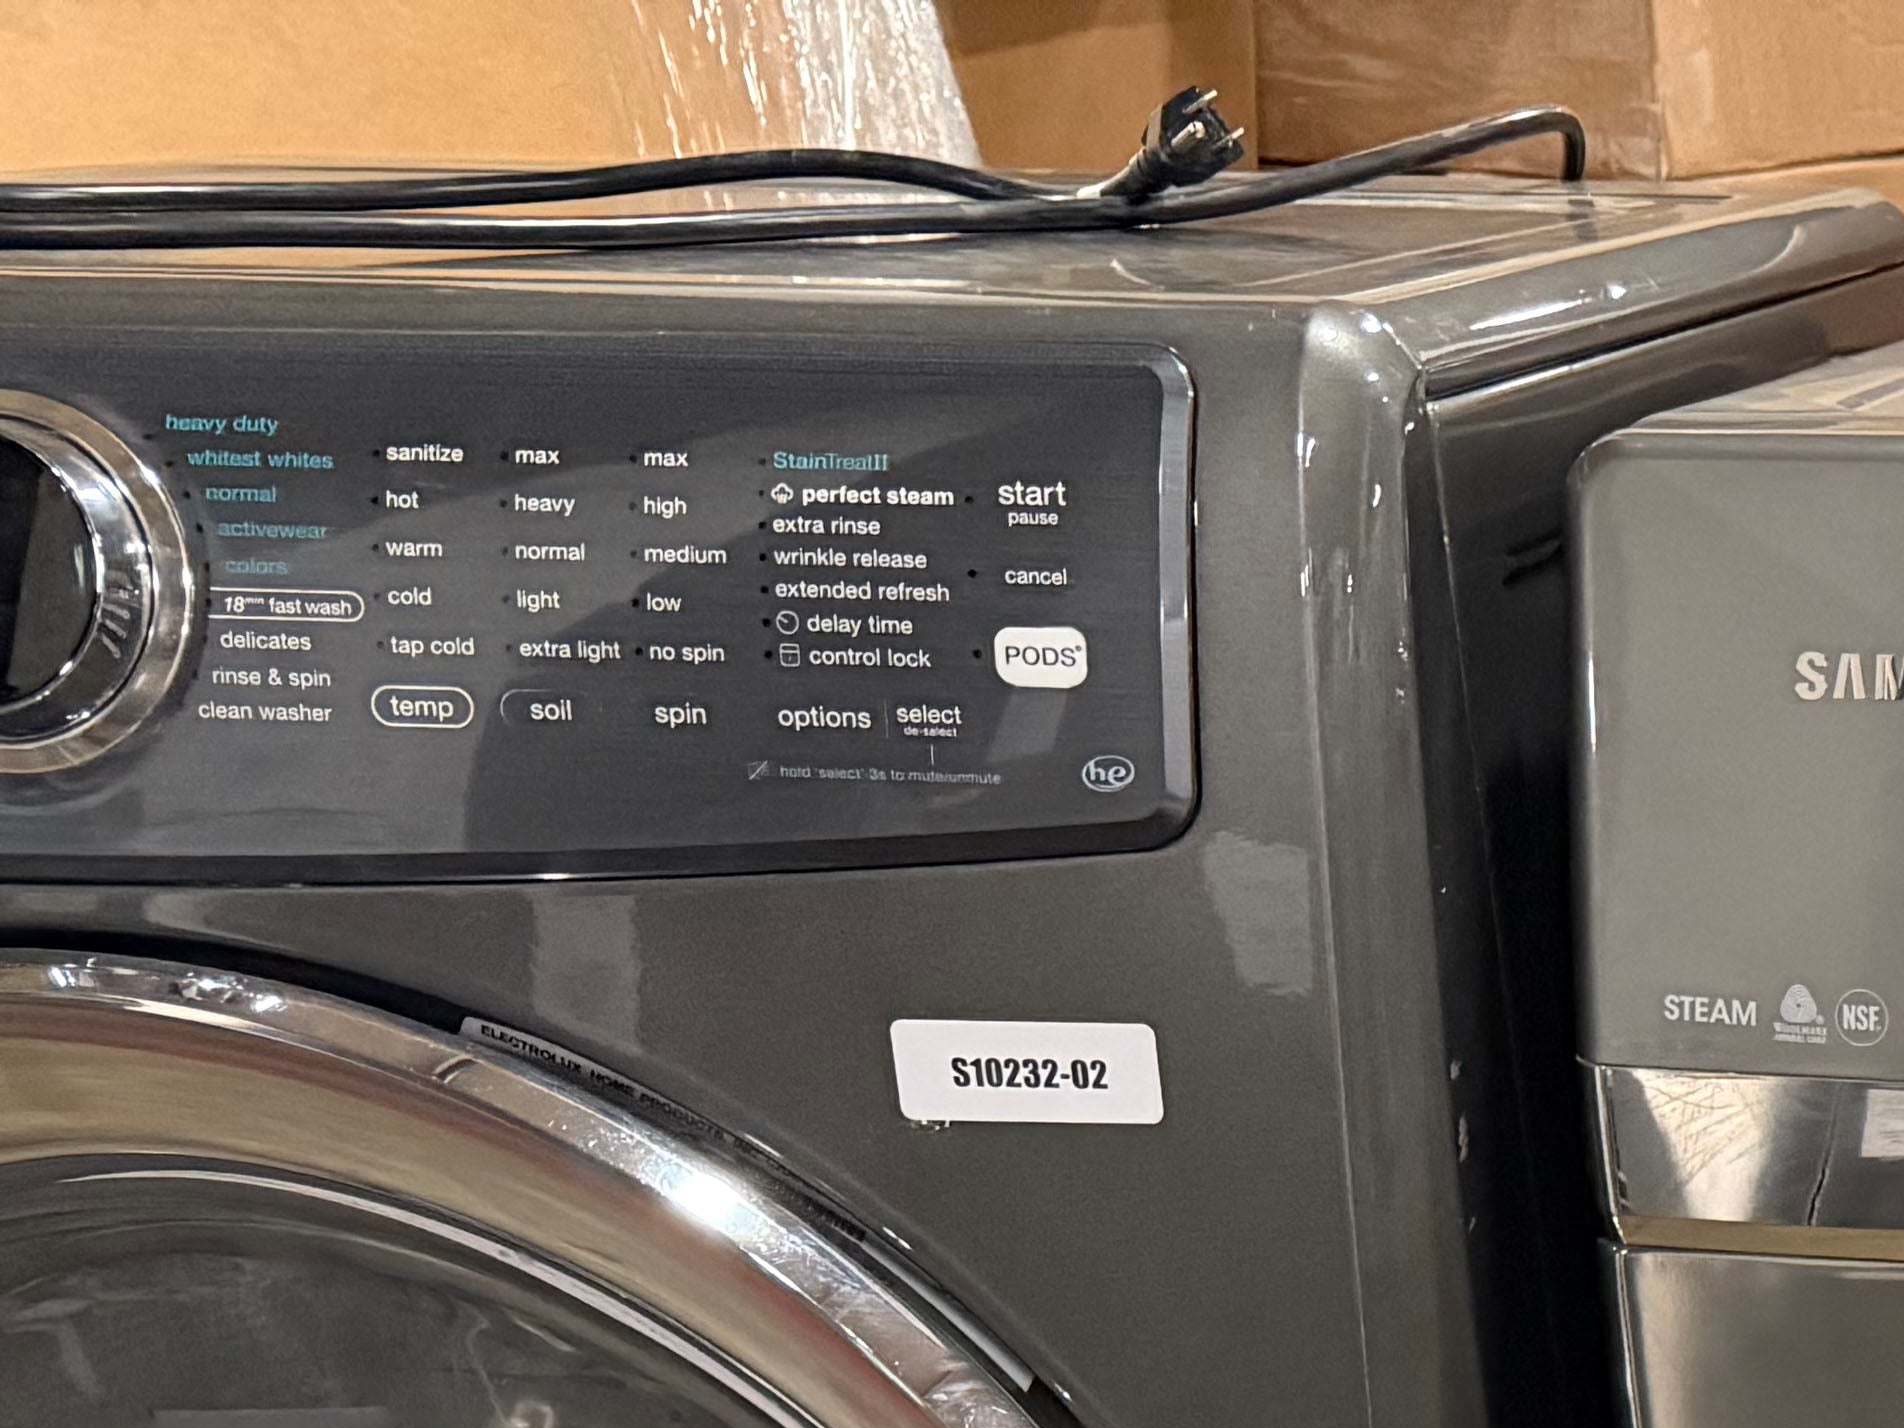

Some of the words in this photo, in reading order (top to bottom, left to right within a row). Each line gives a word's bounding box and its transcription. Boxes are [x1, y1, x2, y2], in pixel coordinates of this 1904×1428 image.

[166, 413, 226, 436] heavy
[233, 415, 279, 437] duty
[187, 450, 261, 467] whitest
[268, 452, 334, 469] whites
[386, 443, 464, 463] sanitize
[515, 449, 560, 465] max
[643, 451, 689, 468] max
[206, 486, 277, 503] normal
[385, 490, 419, 509] hot
[802, 485, 882, 506] perfect
[886, 487, 955, 506] steam
[998, 480, 1067, 507] start
[514, 493, 576, 517] heavy
[643, 495, 687, 519] high
[772, 516, 825, 534] extra
[830, 516, 881, 535] rinse
[1007, 511, 1059, 527] pause
[218, 521, 327, 539] activewear
[385, 541, 443, 557] warm
[515, 543, 586, 562] normal
[644, 545, 727, 565] medium
[774, 547, 847, 567] wrinkle
[853, 549, 928, 569] release
[226, 557, 288, 575] colors
[1004, 568, 1068, 586] cancel
[387, 587, 432, 605] cold
[517, 589, 561, 613] light
[646, 592, 682, 612] low
[775, 581, 871, 600] extended
[878, 582, 950, 602] refresh
[269, 597, 302, 614] fast
[305, 600, 352, 616] wash
[806, 613, 862, 638] delay
[868, 614, 913, 635] time
[220, 631, 312, 651] delicates
[391, 636, 424, 658] tap
[430, 637, 475, 656] cold
[519, 640, 572, 659] extra
[578, 640, 622, 664] light
[649, 645, 675, 661] no
[681, 643, 725, 665] spin
[809, 648, 881, 667] control
[888, 648, 932, 668] lock
[212, 666, 262, 686] rinse
[268, 668, 283, 686] &
[288, 669, 331, 690] spin
[198, 701, 253, 720] clean
[258, 703, 332, 722] washer
[390, 695, 454, 722] temp
[530, 699, 573, 721] soil
[655, 702, 707, 729] spin
[778, 705, 872, 732] options
[896, 704, 962, 725] select
[1664, 994, 1757, 1027] STEAM
[1842, 1003, 1880, 1031] NSF
[951, 1057, 1109, 1090] S10232-02
